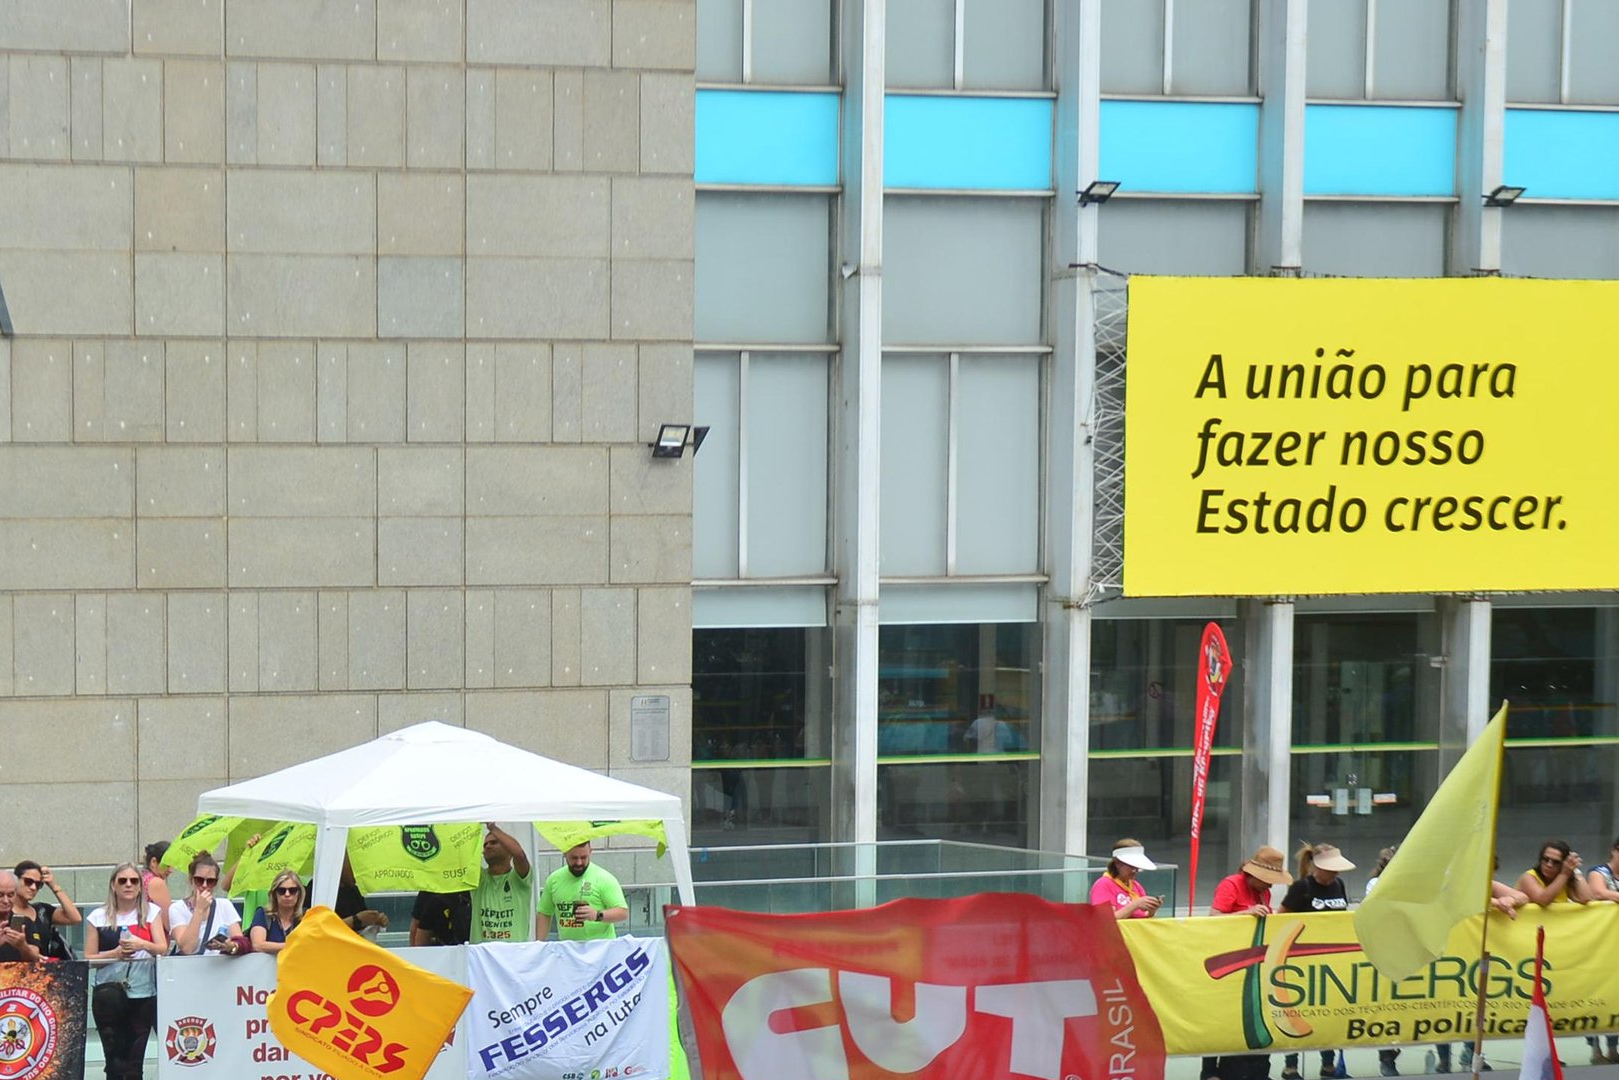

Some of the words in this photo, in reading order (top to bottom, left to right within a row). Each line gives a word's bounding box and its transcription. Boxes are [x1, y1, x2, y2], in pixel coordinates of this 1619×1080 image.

[1194, 354, 1227, 399] A
[1245, 347, 1387, 400] união
[1401, 361, 1518, 412] para
[1190, 418, 1326, 479] fazer
[1340, 428, 1484, 466] nosso
[1196, 485, 1367, 535] Estado
[1384, 493, 1568, 532] crescer.
[29, 993, 42, 1004] DO
[40, 1001, 53, 1017] RIO
[478, 946, 651, 1073] FESSERGS
[487, 986, 554, 1029] Sempre
[584, 1022, 609, 1046] na
[609, 993, 642, 1026] luta
[1271, 1007, 1329, 1018] SINDICATO
[1331, 1007, 1355, 1017] DOS
[286, 989, 410, 1074] CPERS
[294, 1026, 332, 1052] SINDICATO
[331, 1047, 357, 1068] FILIADO
[1346, 1016, 1406, 1040] Boa
[23, 1066, 40, 1080] SUL
